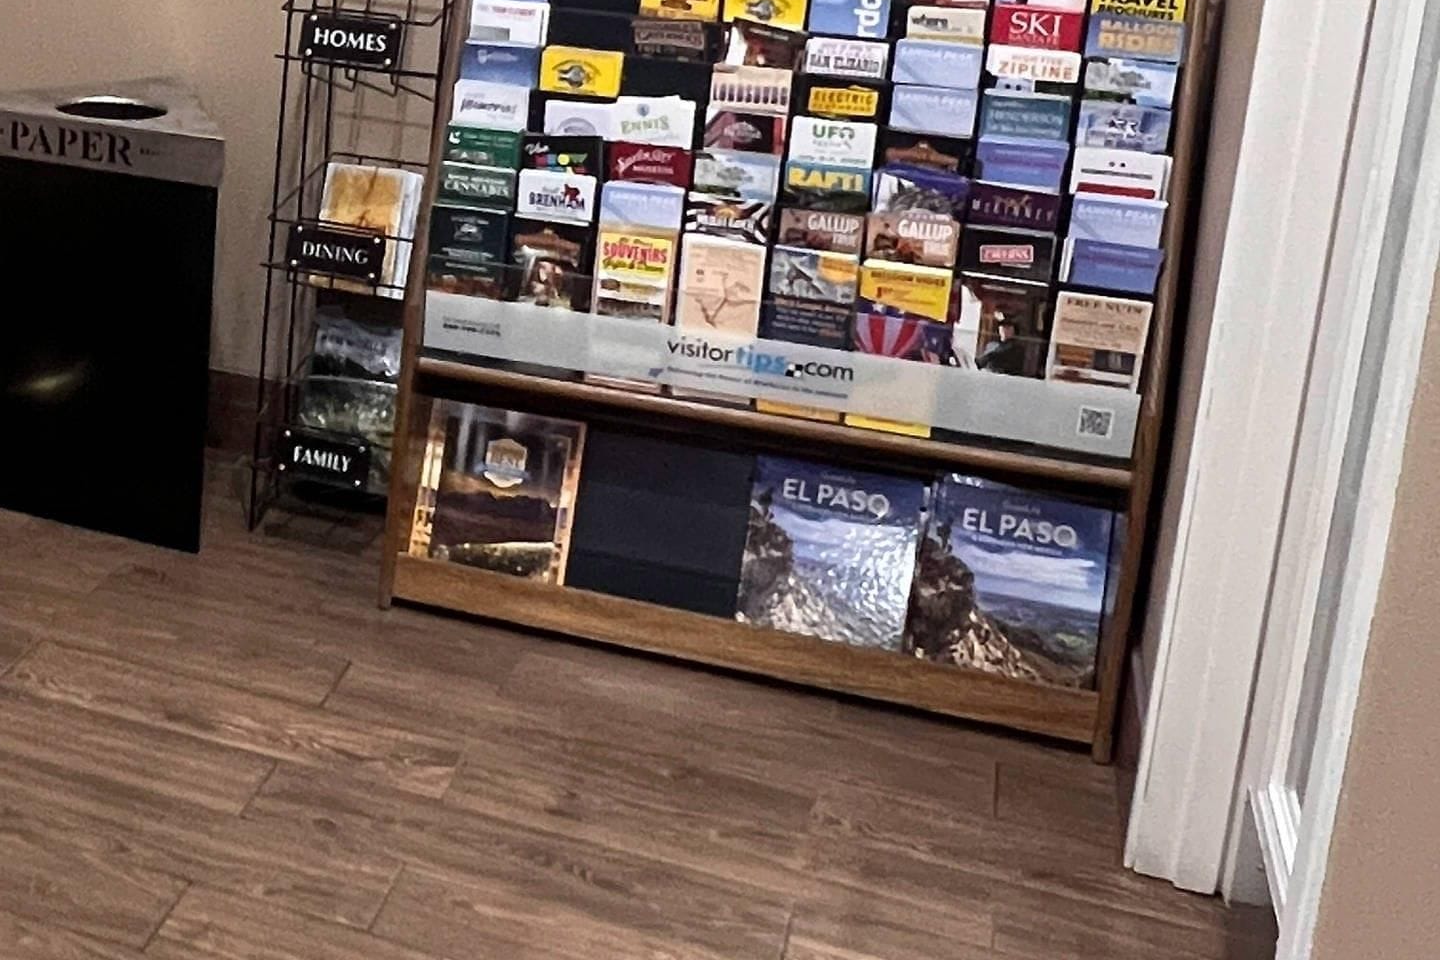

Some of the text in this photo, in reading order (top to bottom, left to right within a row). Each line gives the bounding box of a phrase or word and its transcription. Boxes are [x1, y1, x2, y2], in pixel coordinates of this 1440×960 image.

[1009, 11, 1063, 37] SKI
[1100, 19, 1178, 36] BALLOON
[313, 27, 387, 53] HOMES
[998, 60, 1073, 80] ZIPLINE
[10, 120, 133, 167] PAPER
[529, 191, 586, 213] BRENHAM
[808, 213, 860, 234] GALLUP
[898, 219, 953, 241] GALLUP
[302, 240, 369, 266] DINING
[603, 242, 668, 264] SOUVENIRS
[293, 445, 352, 473] FAMILY
[782, 477, 812, 503] EL
[817, 483, 890, 517] PASO
[962, 507, 1078, 549] EL PASO
